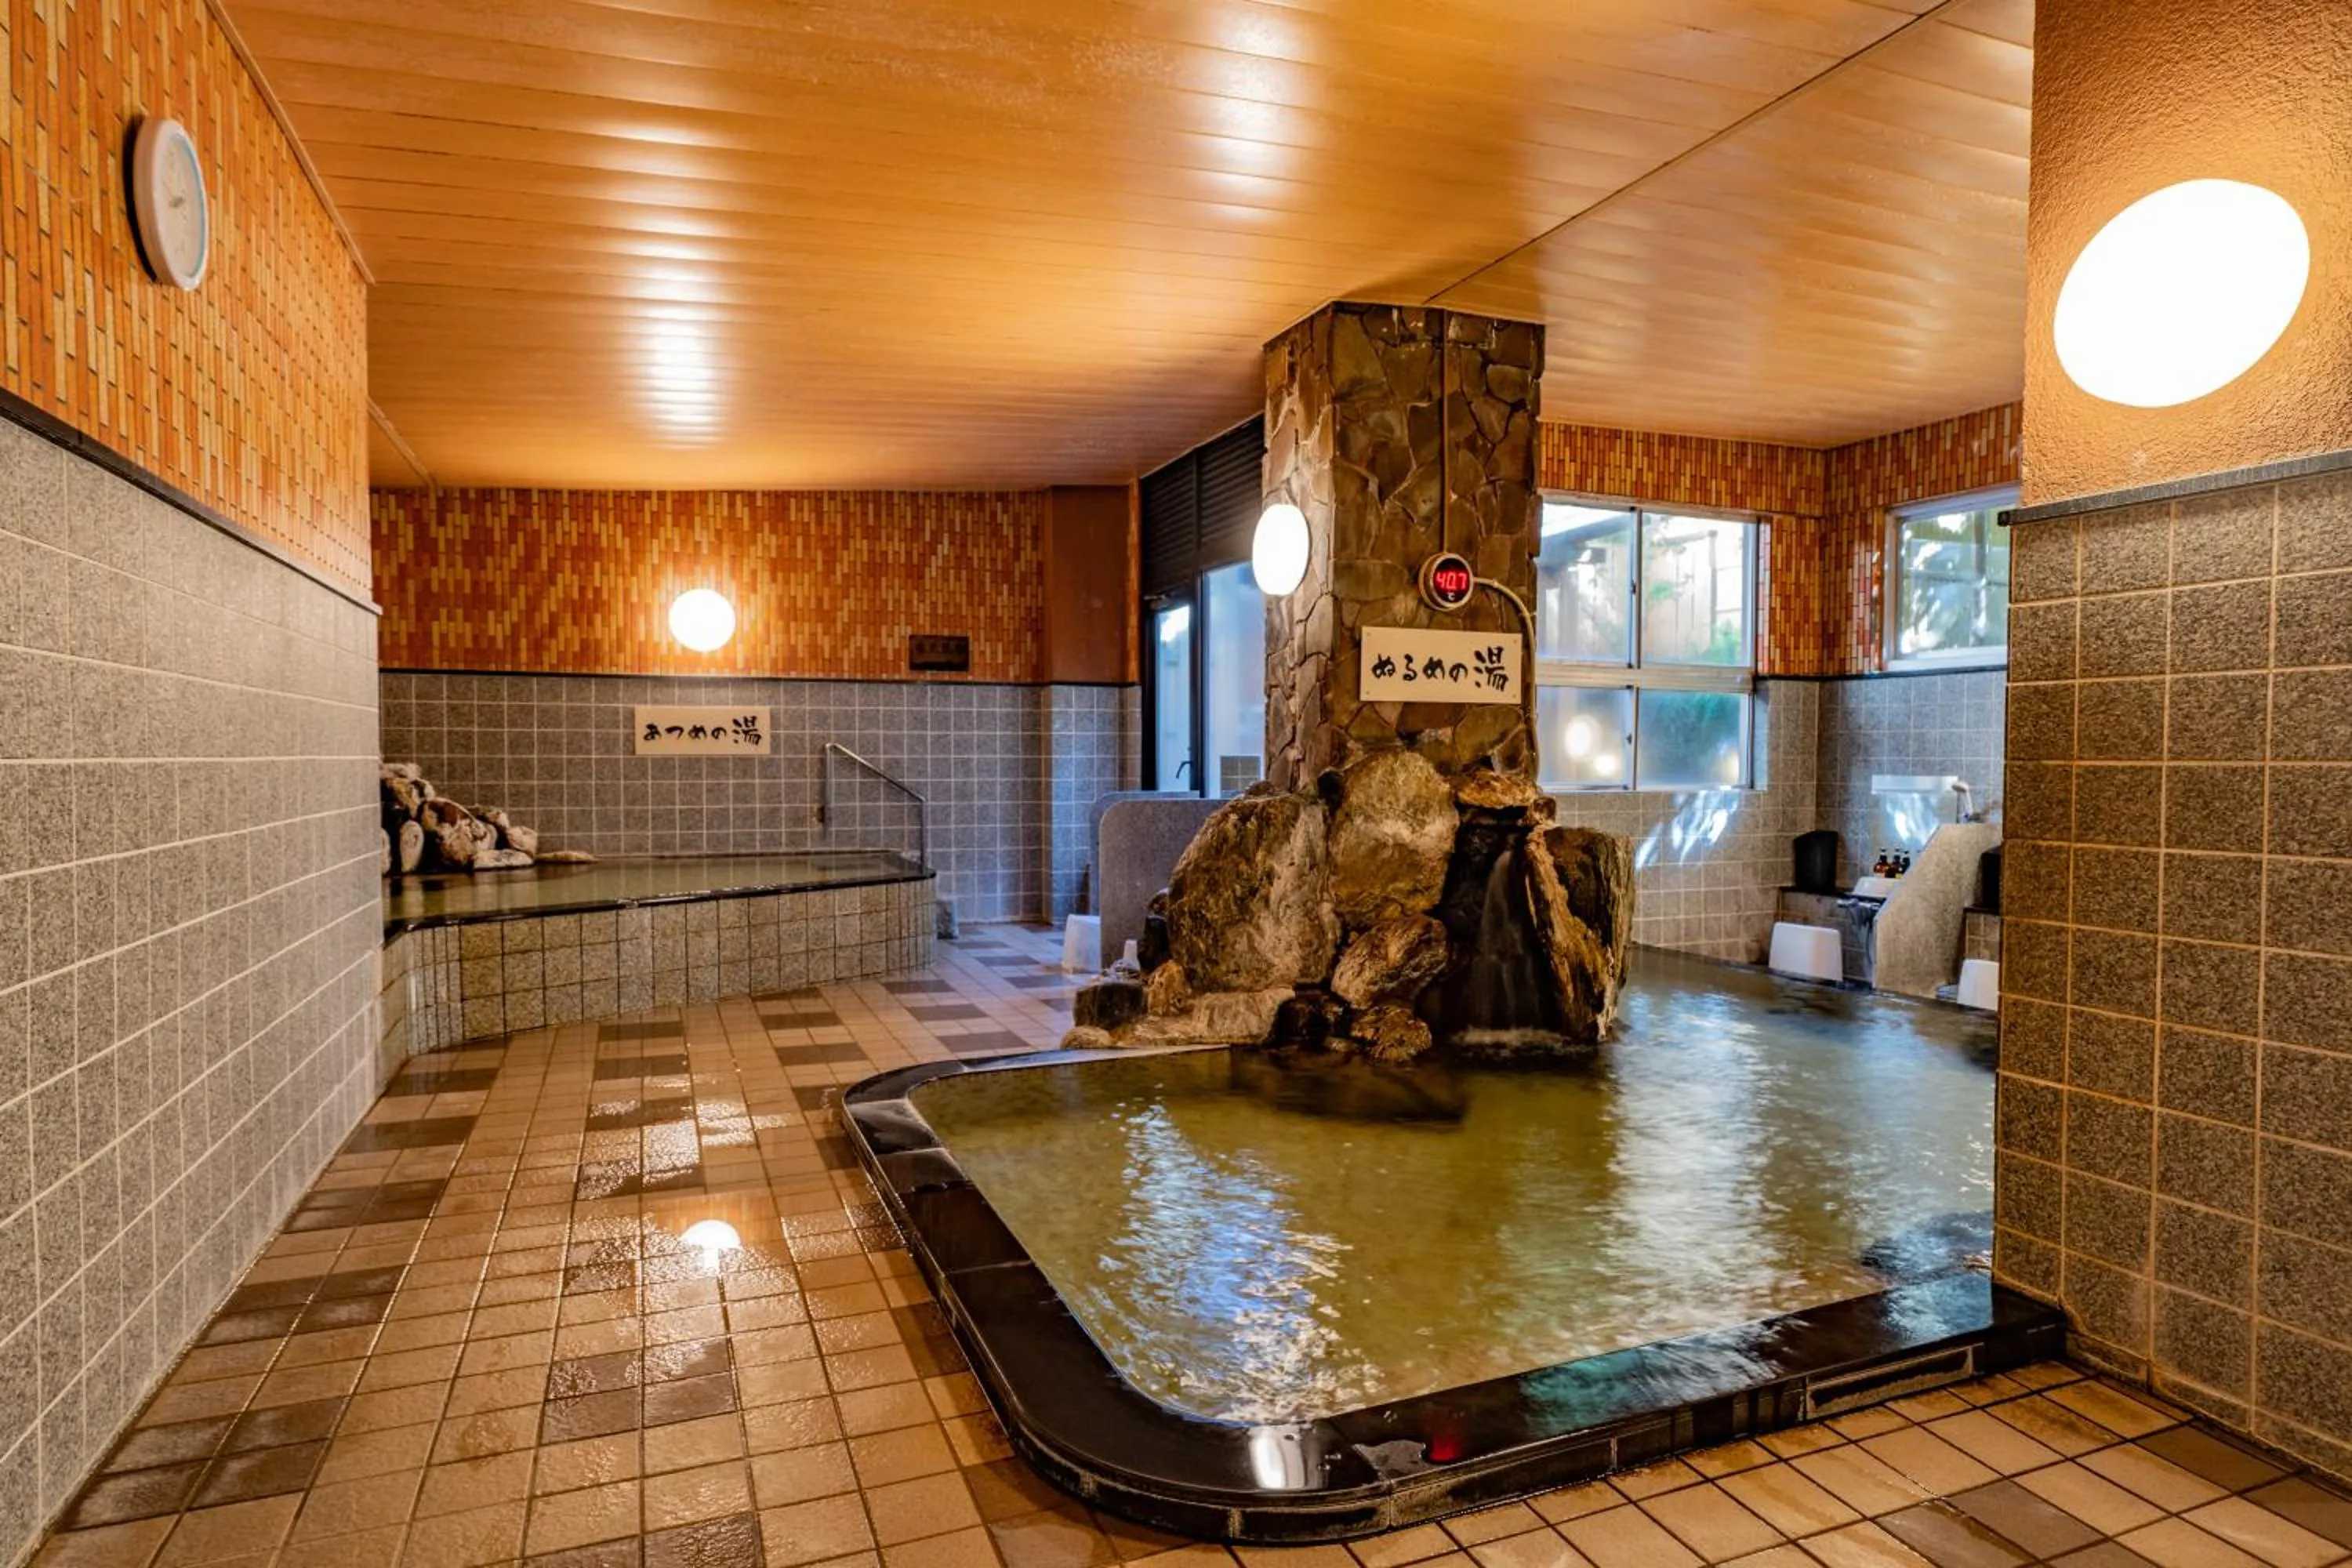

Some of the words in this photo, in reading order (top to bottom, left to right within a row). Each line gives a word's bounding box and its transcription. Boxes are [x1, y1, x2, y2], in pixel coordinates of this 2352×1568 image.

[1371, 646, 1509, 691] ぬるめの湯
[643, 716, 762, 746] あつめの湯
